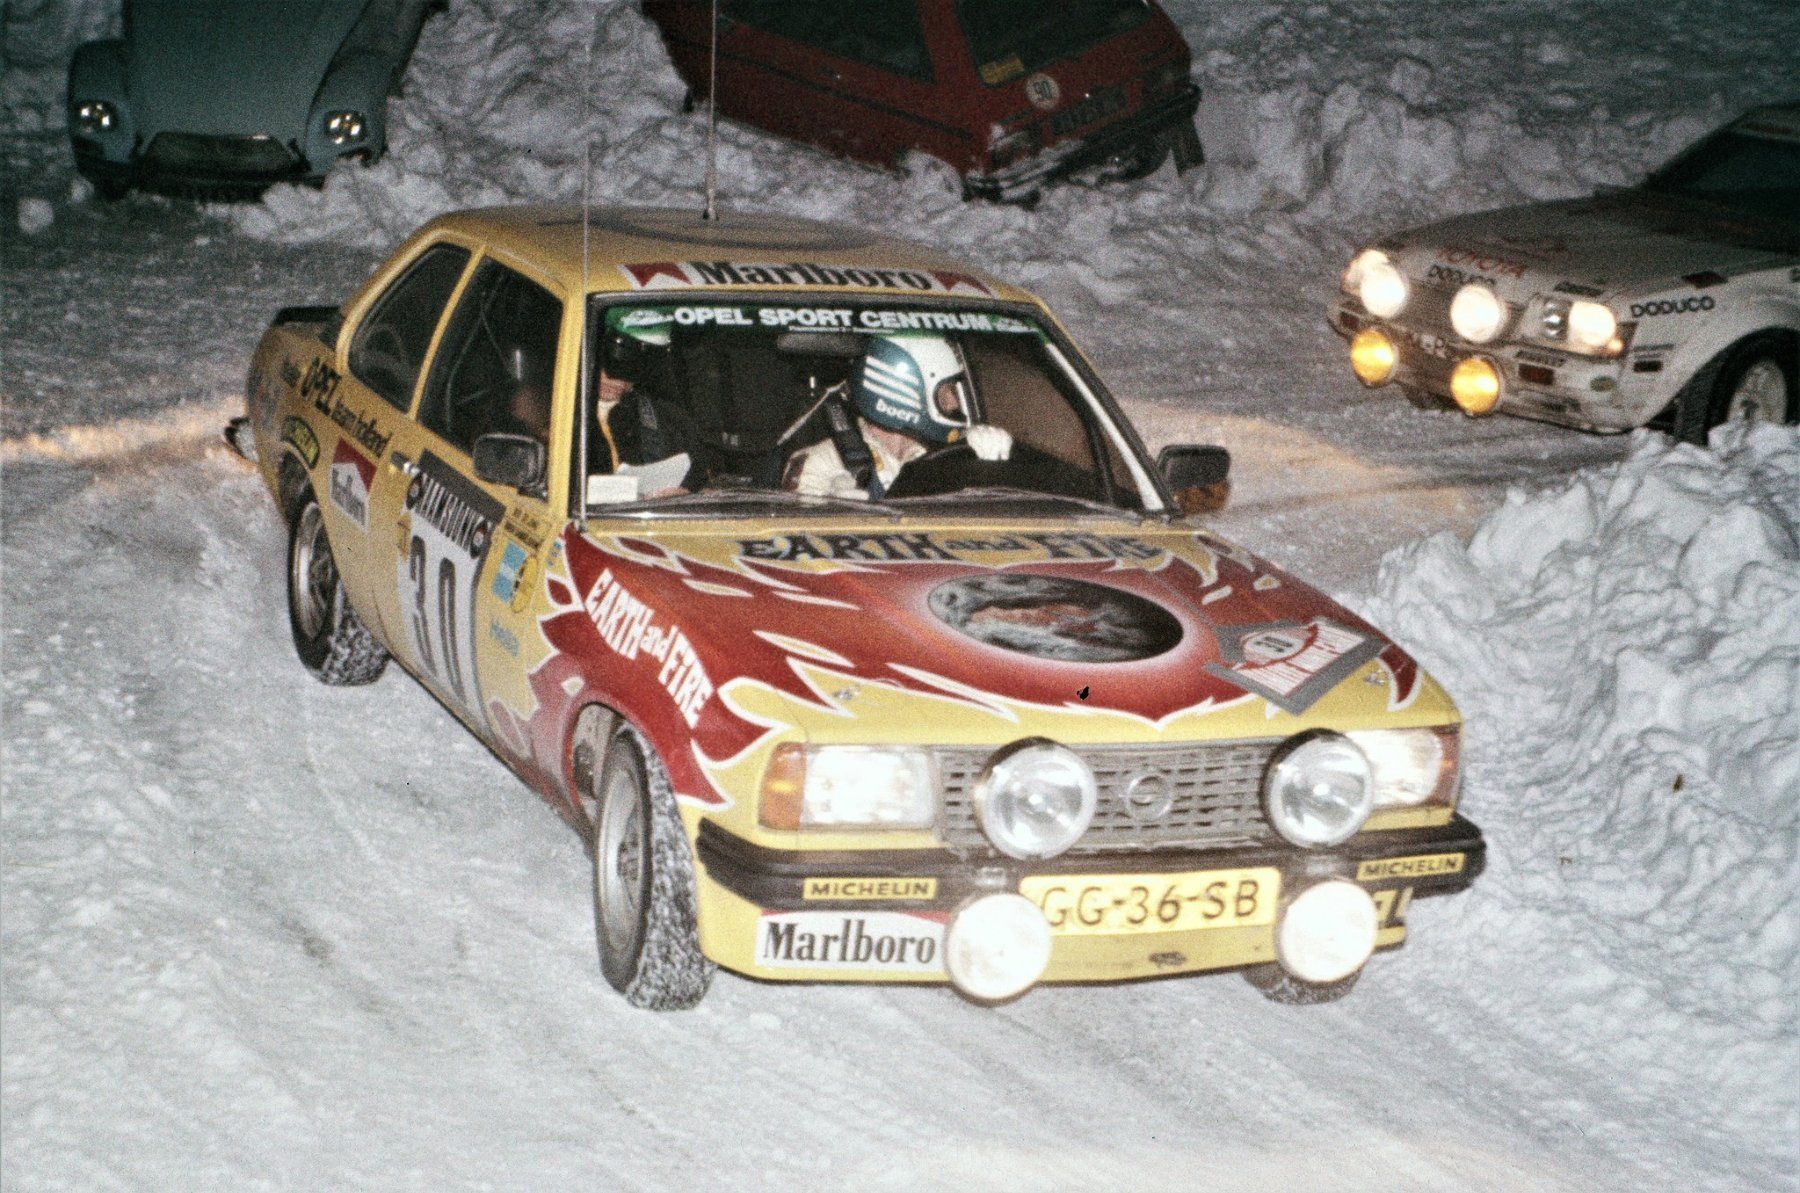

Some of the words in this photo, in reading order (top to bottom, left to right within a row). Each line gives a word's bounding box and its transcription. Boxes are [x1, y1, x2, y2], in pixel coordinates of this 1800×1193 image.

[689, 261, 933, 290] Marlboro
[674, 307, 753, 326] OPEL
[758, 308, 853, 328] SPORT
[859, 310, 993, 331] CENTRUM
[1630, 295, 1715, 318] DODUCO
[738, 533, 962, 561] EARTH
[944, 534, 1029, 551] and
[1022, 532, 1163, 560] FIRE
[585, 567, 655, 661] EARTH
[639, 625, 679, 664] and
[658, 631, 714, 730] FIRE
[1364, 857, 1457, 876] MICHELIN
[811, 882, 929, 896] MICHELIN
[1040, 879, 1260, 927] GG-36-SB
[763, 918, 936, 964] Marlboro
